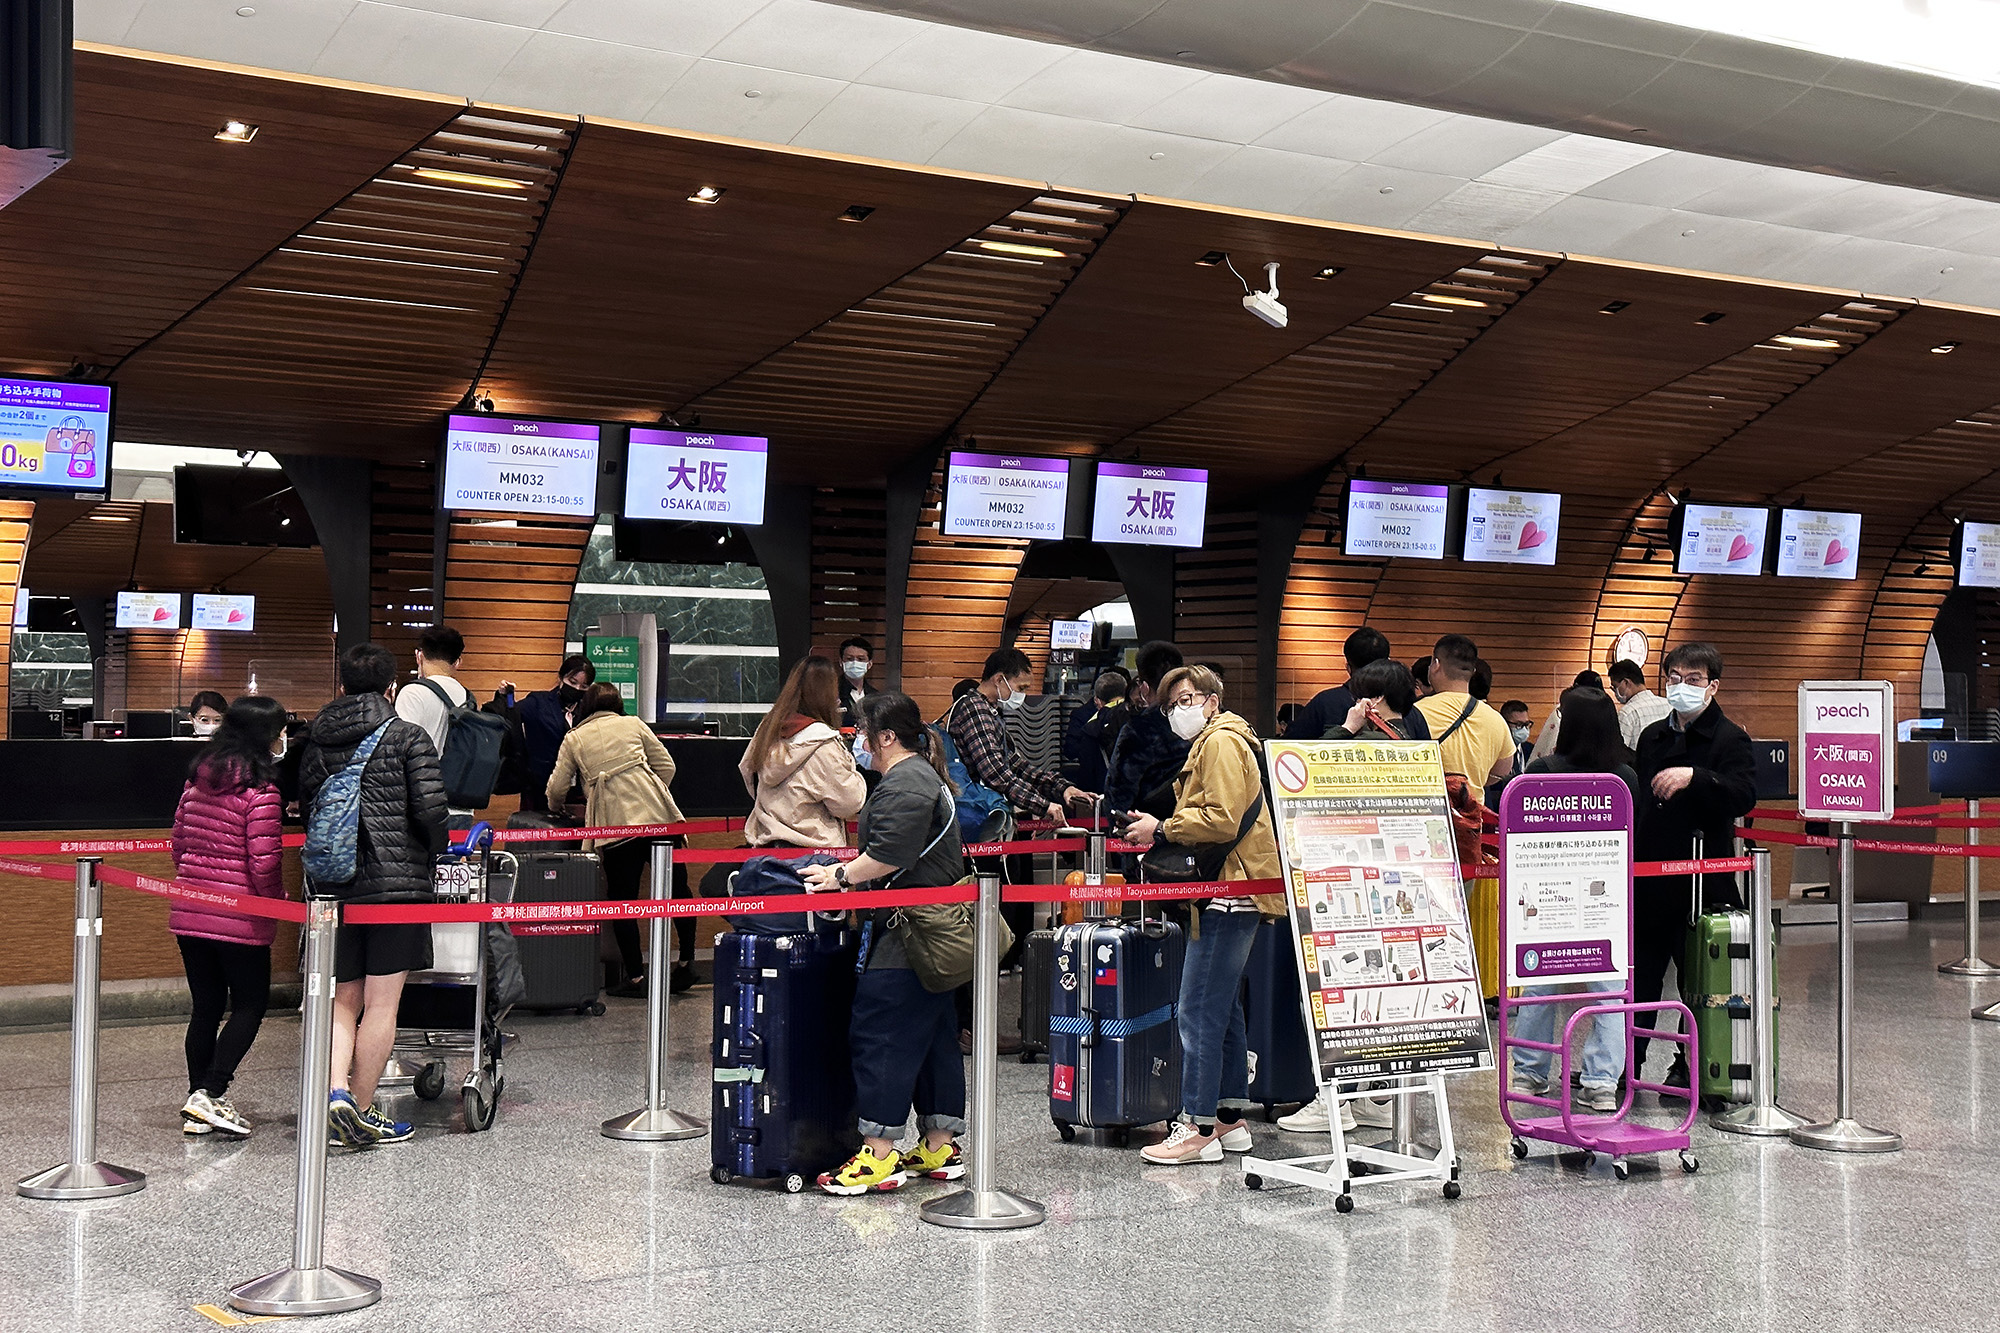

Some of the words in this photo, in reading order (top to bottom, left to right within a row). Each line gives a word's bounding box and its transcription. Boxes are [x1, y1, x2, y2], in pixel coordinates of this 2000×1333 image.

[512, 424, 539, 433] peach
[685, 436, 715, 446] peach
[452, 440, 501, 454] 大阪(関西)
[512, 445, 594, 460] OSAKA(KANSAI)
[1000, 458, 1021, 467] peach
[500, 472, 544, 486] MM032
[666, 458, 728, 494] 大阪
[1142, 468, 1166, 478] peach
[952, 474, 991, 486] 大阪(関西)
[998, 478, 1065, 490] OSAKA(KANSAI)
[1392, 485, 1408, 494] peach
[456, 490, 501, 502] COUNTER
[504, 492, 529, 502] OPEN
[532, 493, 584, 506] 23:15-00:55
[660, 498, 732, 512] OSAKA(関西)
[1126, 488, 1176, 520] 大阪
[988, 502, 1024, 514] MM032
[1390, 502, 1444, 514] OSAKA(KANSAI)
[954, 518, 990, 528] COUNTER
[992, 520, 1012, 529] OPEN
[1014, 520, 1056, 532] 23:15-00:55
[1120, 523, 1178, 537] OSAKA(関西)
[1382, 524, 1411, 536] MM032
[1354, 540, 1383, 548] COUNTER
[1384, 541, 1400, 549] OPEN
[48, 714, 60, 722] 12
[1816, 702, 1870, 720] peach
[1770, 749, 1785, 763] 10
[1813, 744, 1873, 763] 大阪(関西)
[1932, 750, 1947, 762] 09
[1820, 774, 1866, 788] OSAKA
[1523, 796, 1578, 811] BAGGAGE
[1582, 796, 1612, 810] RULE
[1822, 794, 1863, 808] (KANSAI)
[549, 830, 572, 838] Taiwan
[573, 830, 600, 838] Taoyuan
[602, 828, 644, 836] International
[644, 826, 668, 835] Airport
[136, 840, 164, 849] Taiwan
[979, 845, 1002, 854] Airport
[1856, 840, 1875, 848] Taiwan
[1876, 841, 1902, 854] Taoyuan
[1902, 843, 1940, 854] International
[1940, 846, 1964, 856] Airport
[1515, 852, 1538, 860] Carry-on
[1538, 852, 1559, 860] baggage
[1126, 886, 1157, 897] Taoyuan
[1158, 884, 1204, 896] International
[1204, 884, 1230, 894] Airport
[492, 906, 584, 920] 臺灣桃園國際機場
[586, 904, 620, 915] Taiwan
[622, 902, 664, 916] Taoyuan
[666, 898, 728, 912] International
[730, 899, 764, 912] Airport
